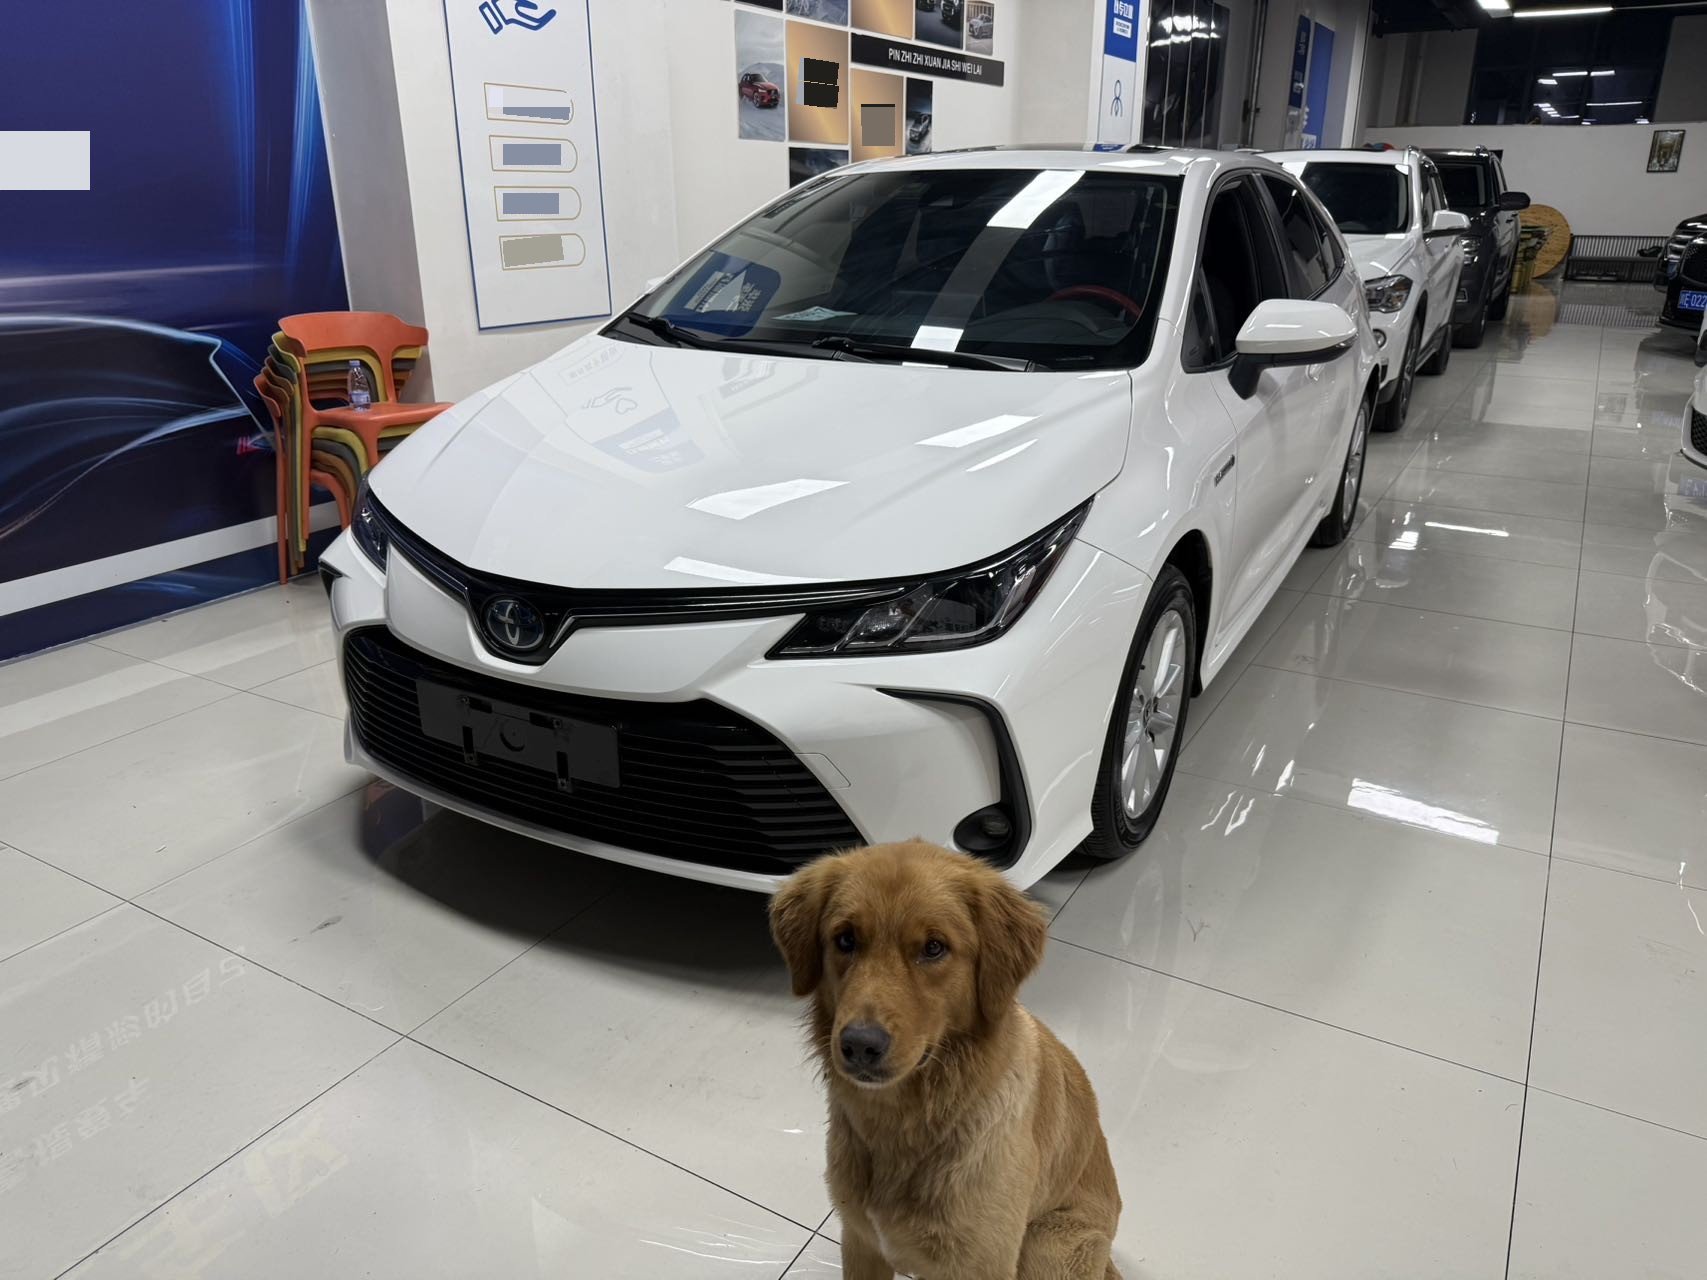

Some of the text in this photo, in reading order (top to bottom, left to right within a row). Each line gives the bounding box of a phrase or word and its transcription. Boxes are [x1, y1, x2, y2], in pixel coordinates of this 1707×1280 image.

[888, 48, 982, 75] PIN ZHI ZHI XUAN JIA SHI WEI LAI
